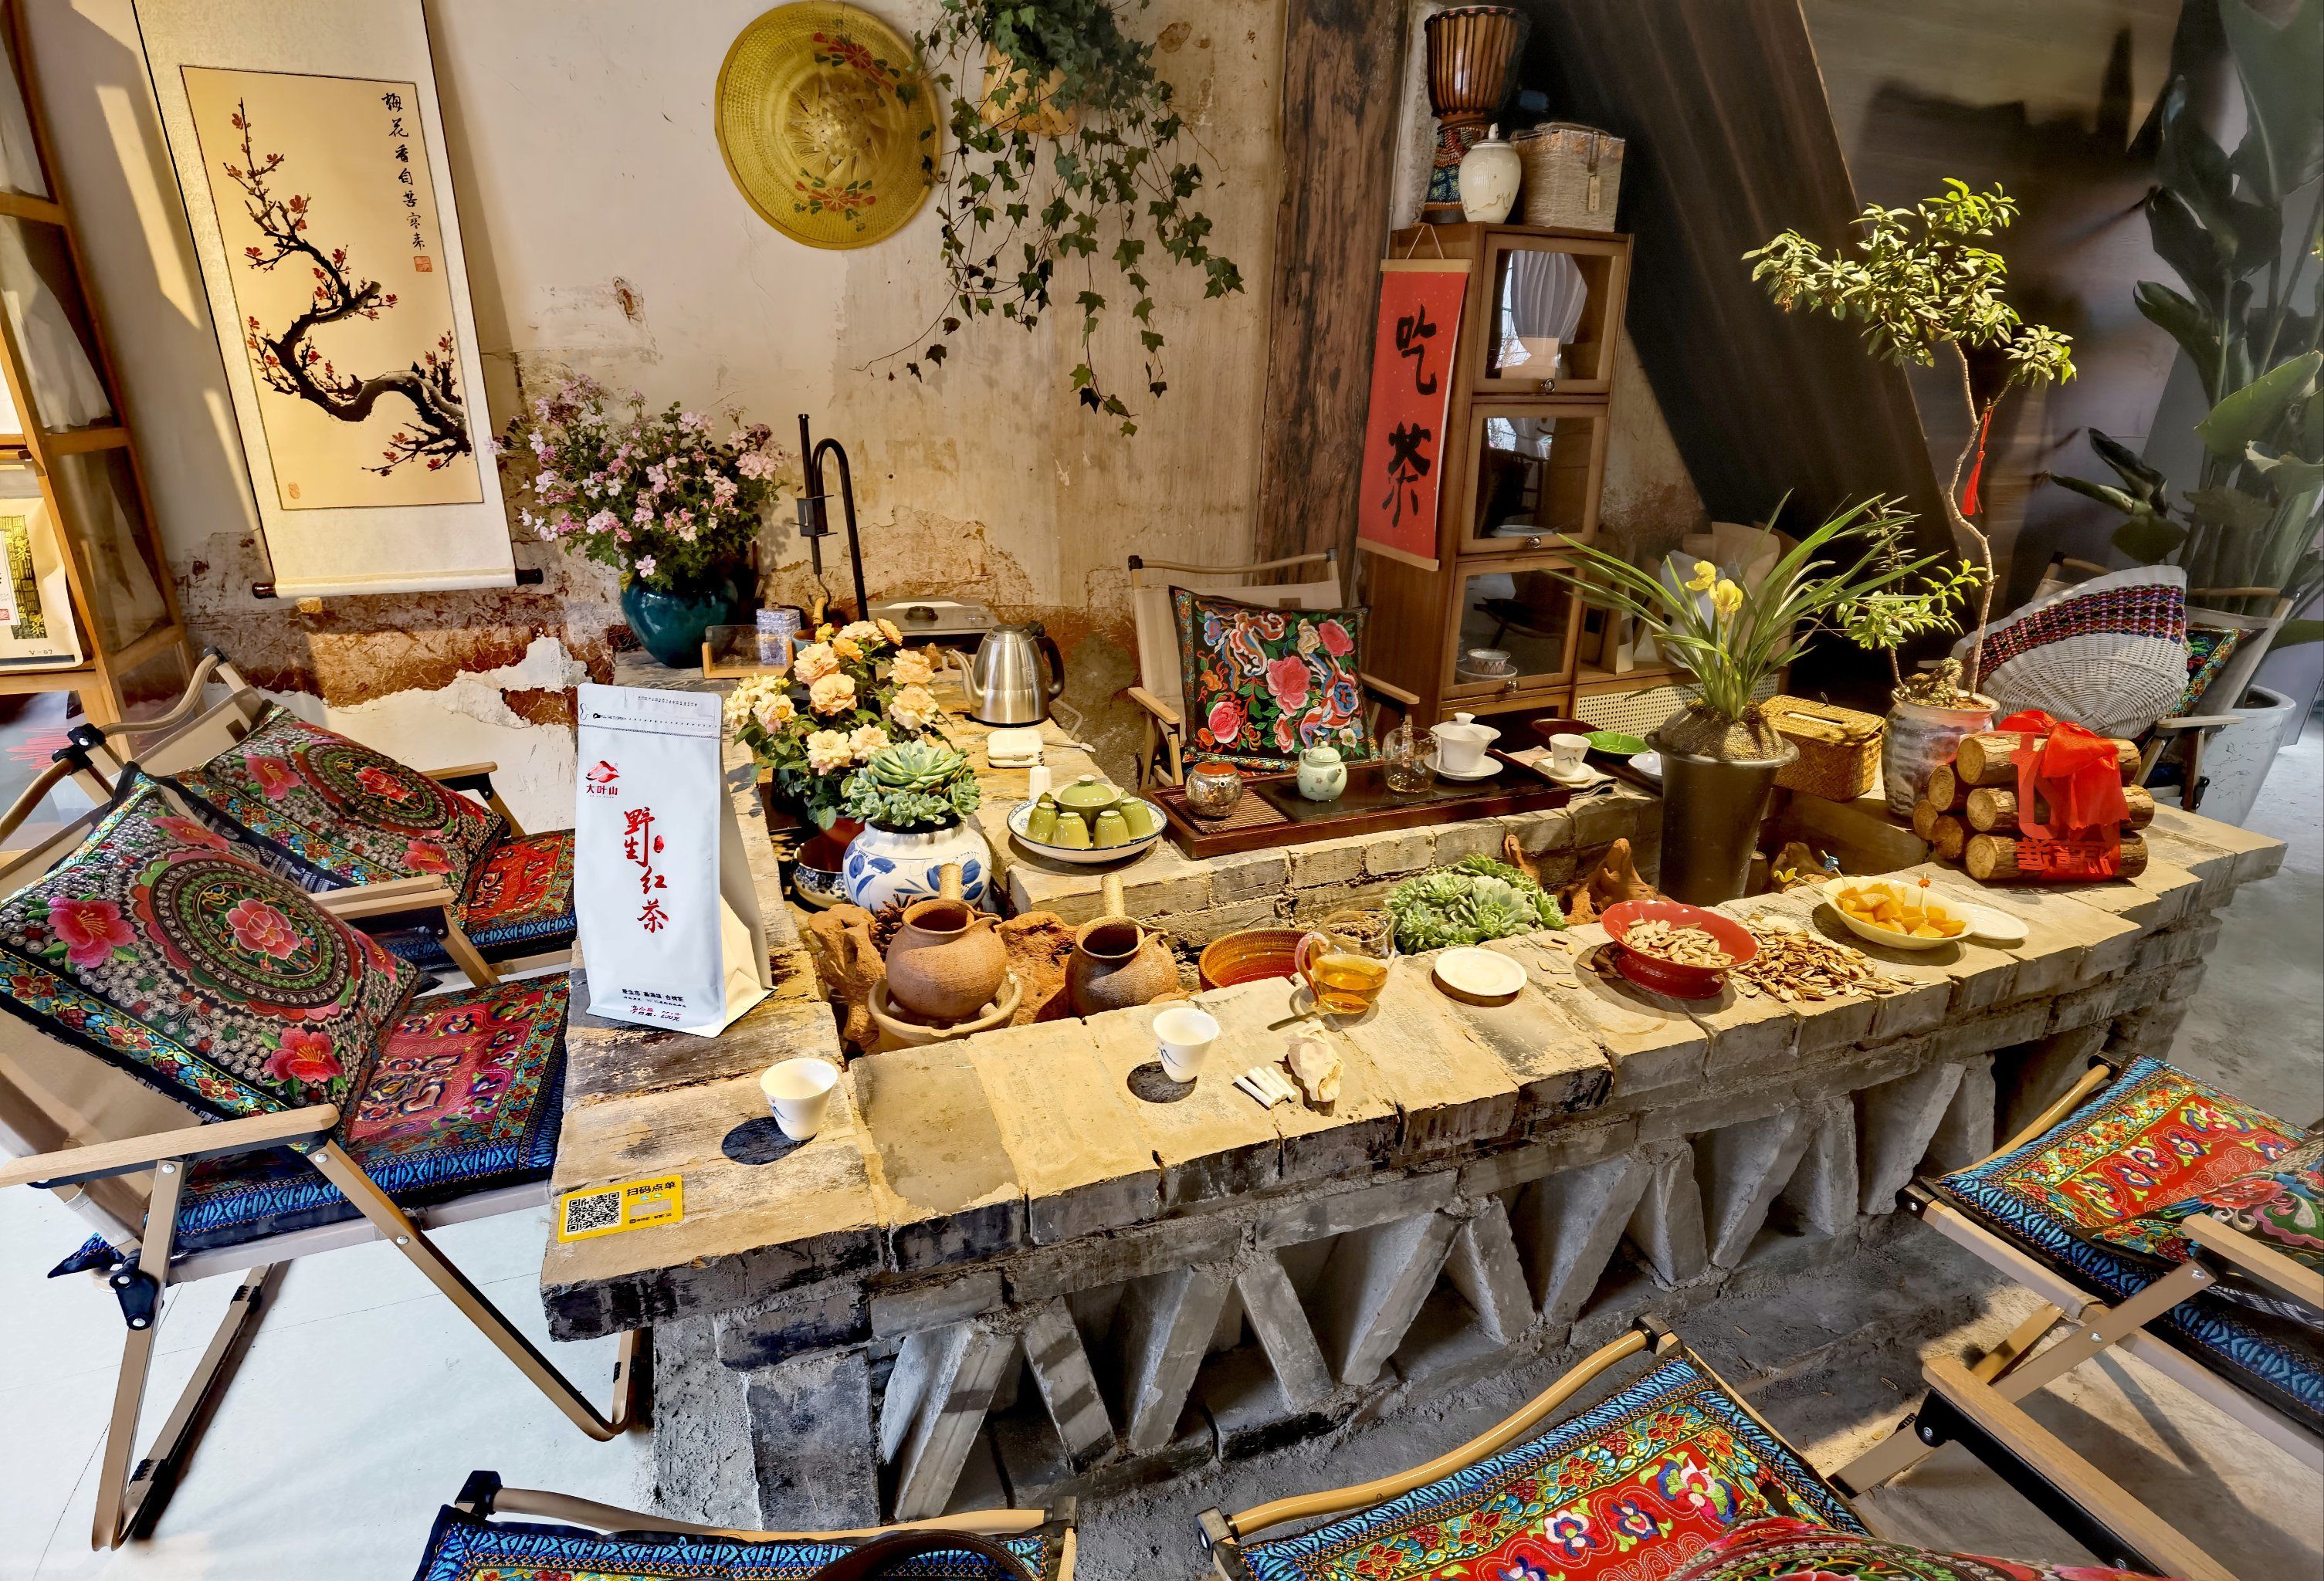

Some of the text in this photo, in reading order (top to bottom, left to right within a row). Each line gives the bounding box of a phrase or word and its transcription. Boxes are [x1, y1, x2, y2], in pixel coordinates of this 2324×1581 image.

[1381, 303, 1438, 528] 吃茶
[586, 784, 618, 796] 大叶山
[626, 1181, 676, 1197] 扫码点单
